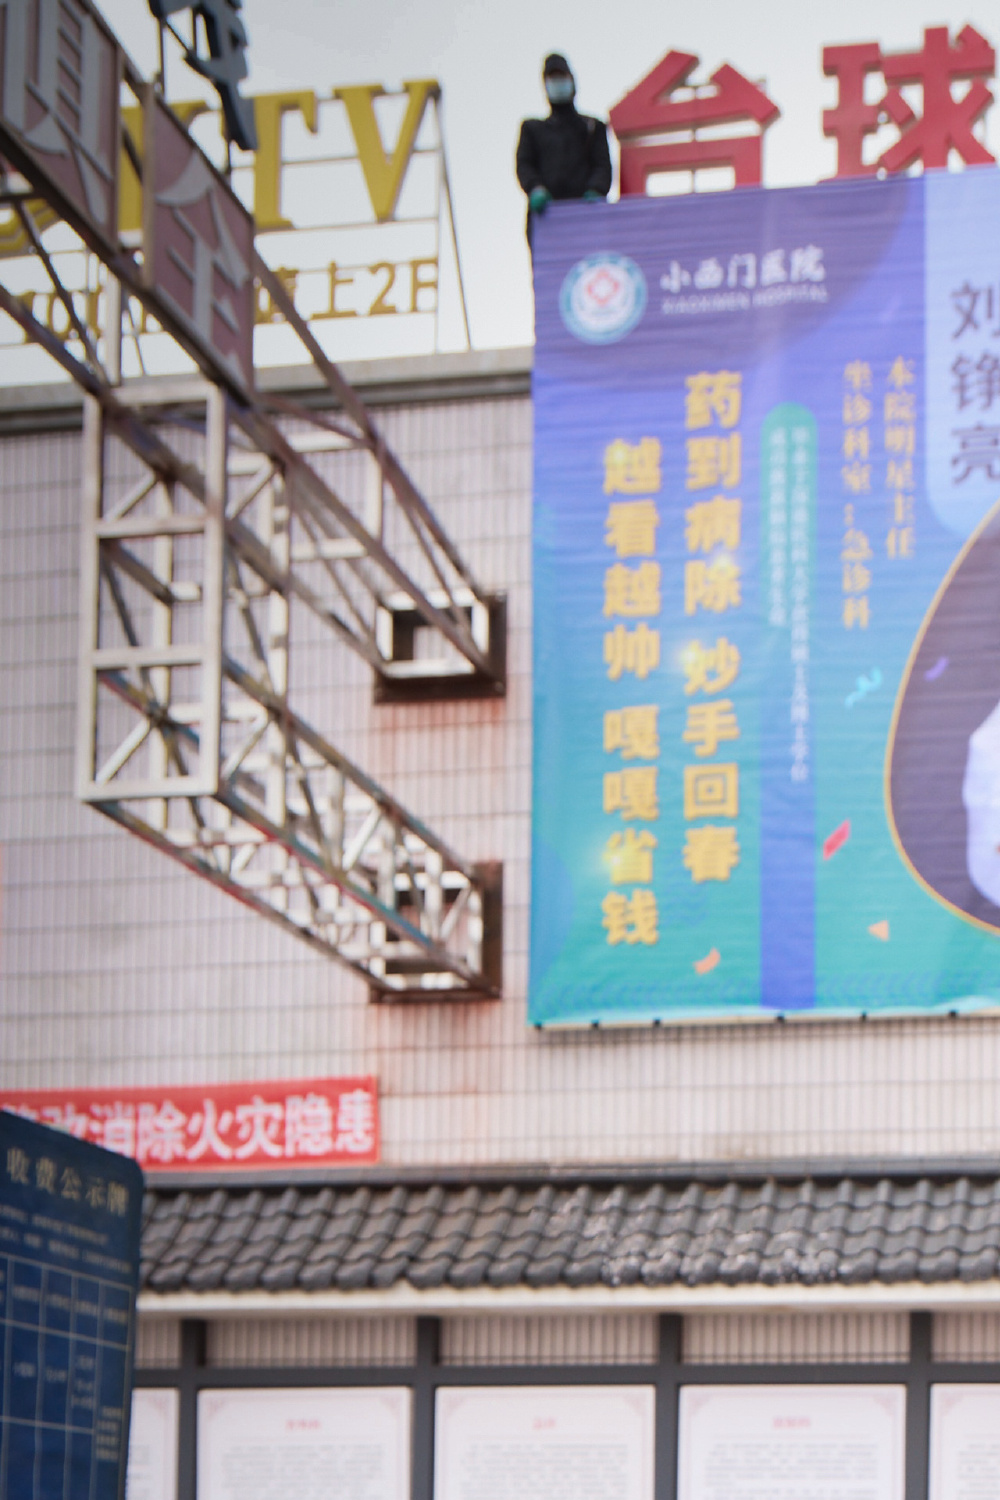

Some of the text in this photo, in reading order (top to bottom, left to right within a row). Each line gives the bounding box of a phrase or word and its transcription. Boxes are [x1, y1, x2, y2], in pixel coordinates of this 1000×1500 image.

[608, 23, 997, 196] 台球
[659, 244, 826, 294] 小西门医院
[602, 436, 662, 946] 越看越帅 嘎嘎省钱
[681, 370, 742, 883] 药到病除 妙手回春
[6, 1146, 130, 1217] 收费公示牌
